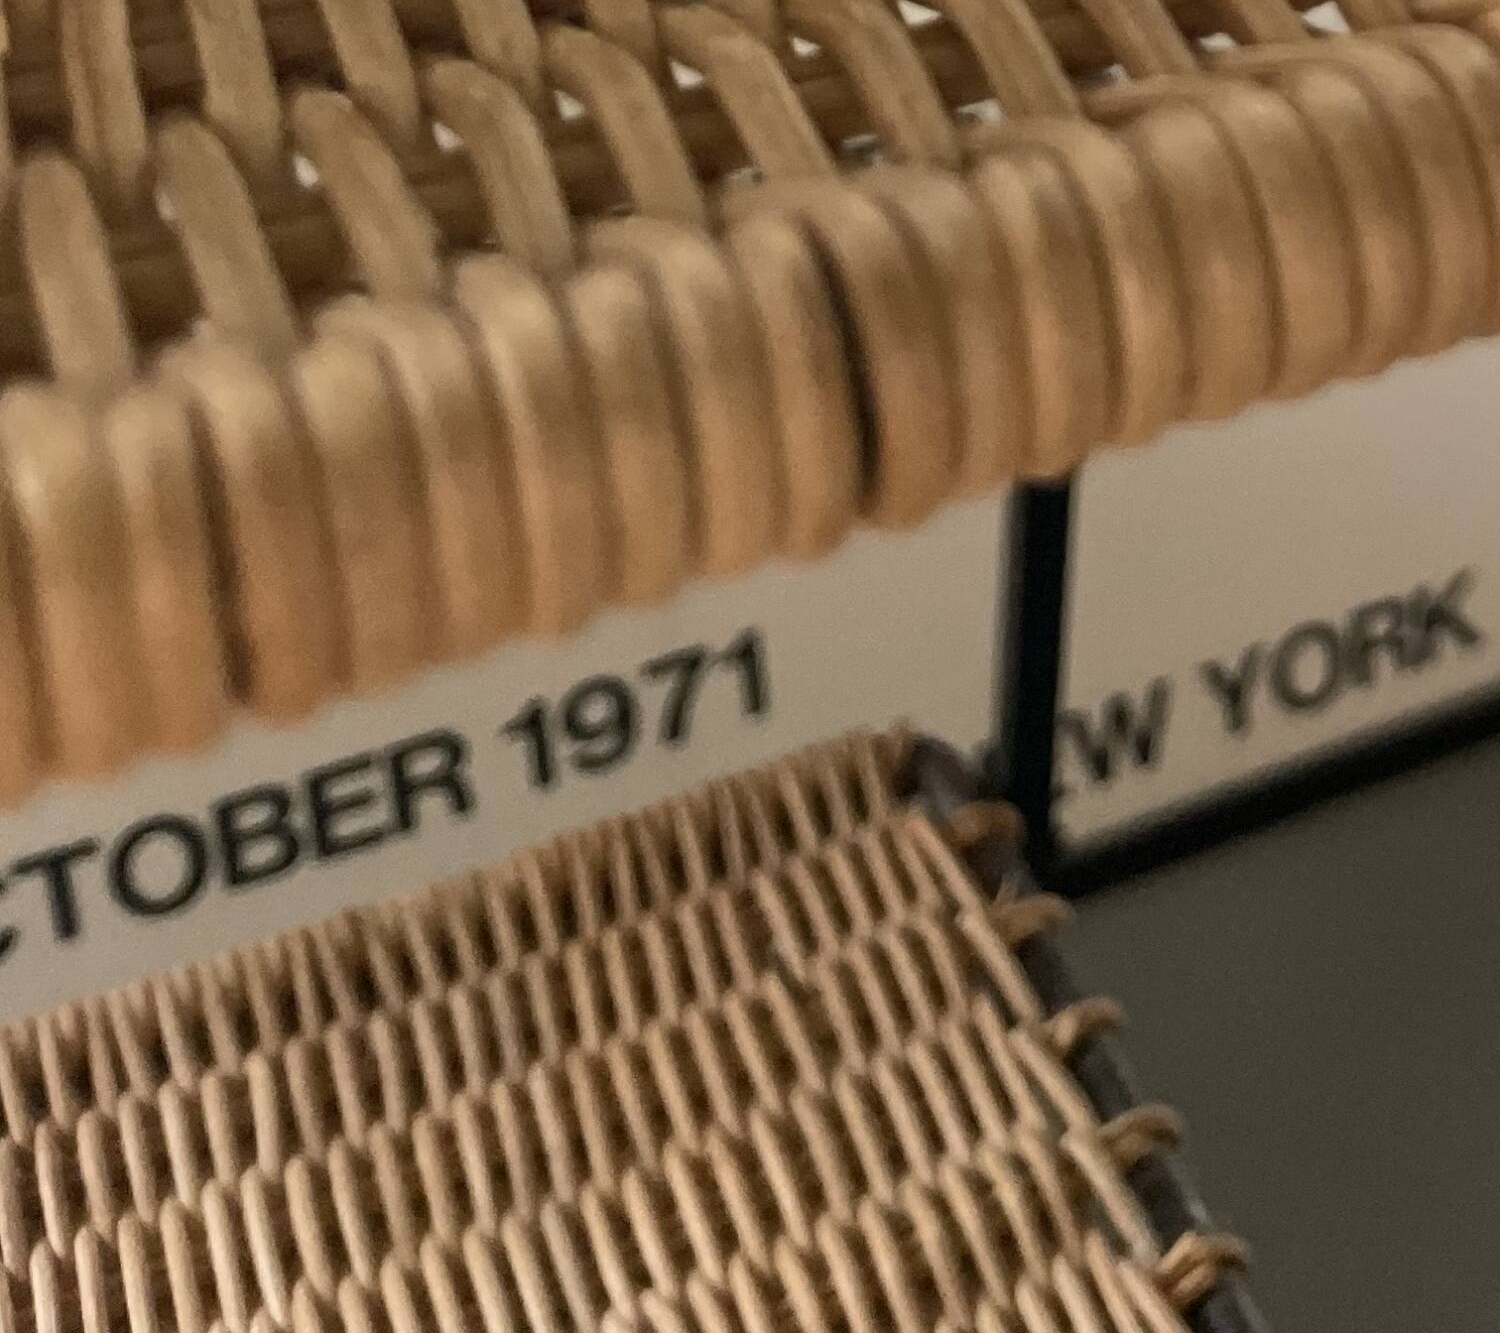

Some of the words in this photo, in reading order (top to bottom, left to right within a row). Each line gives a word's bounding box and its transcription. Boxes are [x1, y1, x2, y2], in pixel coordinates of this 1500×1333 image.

[0, 728, 474, 963] TOBER
[505, 626, 771, 787] 1971
[1054, 675, 1171, 795] W
[1200, 565, 1481, 733] YORK
